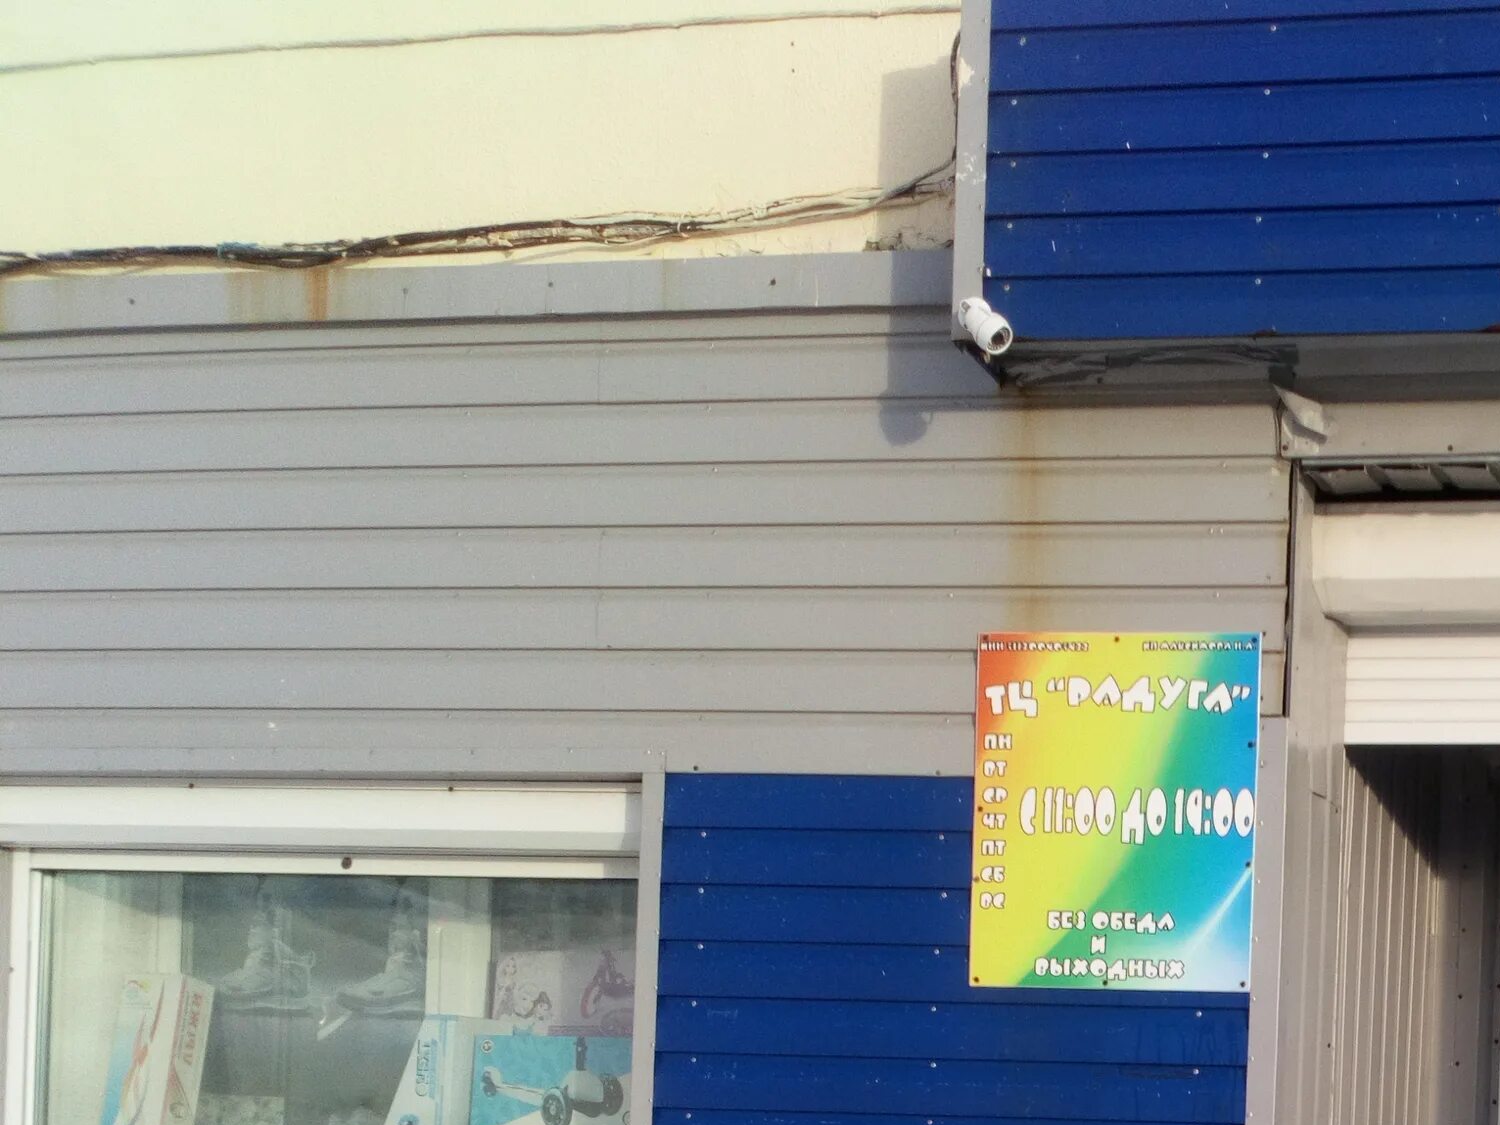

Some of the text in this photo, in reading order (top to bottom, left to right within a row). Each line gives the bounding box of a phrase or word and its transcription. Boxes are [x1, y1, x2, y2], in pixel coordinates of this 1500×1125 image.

[985, 674, 1251, 718] ТЦ "РАДУГА"
[983, 733, 1013, 750] ПН
[983, 760, 1007, 777] ВТ
[982, 786, 1008, 803] СР
[982, 812, 1007, 830] ЧТ
[1019, 786, 1255, 845] С 11:00 ДО 19:00
[981, 839, 1006, 856] ПТ
[980, 865, 1006, 883] СБ
[979, 891, 1006, 909] ВС
[1047, 910, 1175, 934] БЕЗ ОБЕДА
[1090, 935, 1106, 955] И
[1034, 957, 1185, 981] ВЫХОДНЫХ
